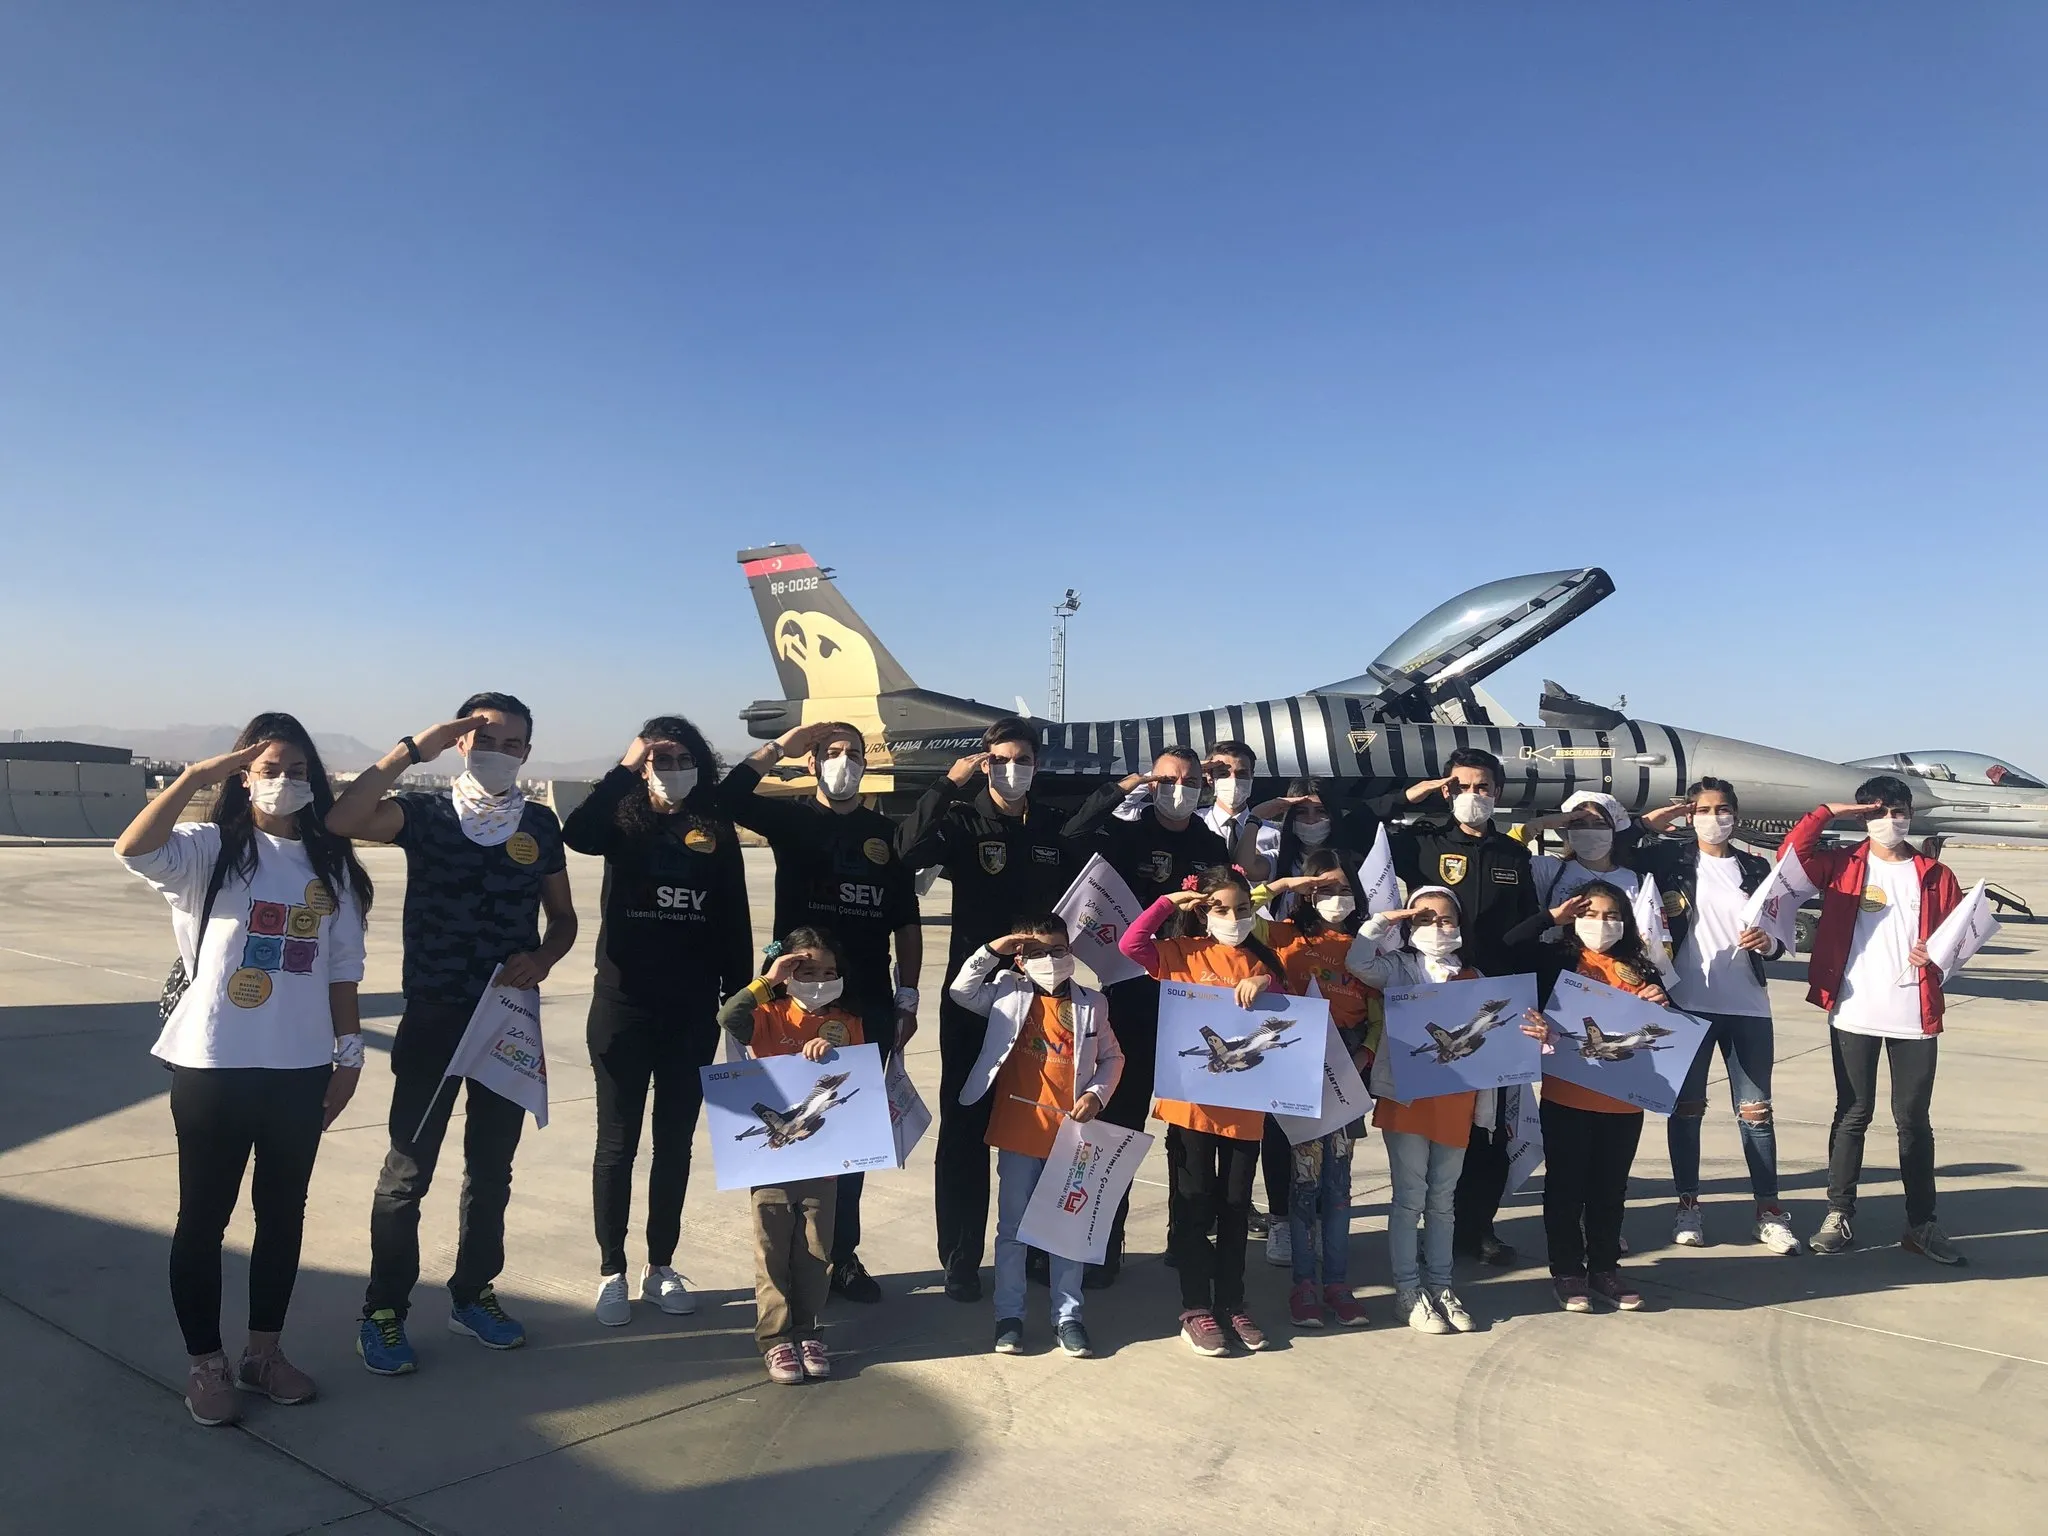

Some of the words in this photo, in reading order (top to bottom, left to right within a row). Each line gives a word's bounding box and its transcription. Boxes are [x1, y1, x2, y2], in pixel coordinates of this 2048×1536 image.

[771, 577, 819, 595] 88-0032
[890, 740, 922, 751] HAVA
[924, 737, 983, 750] KUVVETL
[1563, 977, 1583, 989] SOLO
[1167, 987, 1187, 997] SOLO
[1391, 993, 1409, 1001] SOLO
[494, 1039, 538, 1071] LÖSEV
[708, 1071, 730, 1081] SOLO
[1071, 1141, 1092, 1191] LÖSEV
